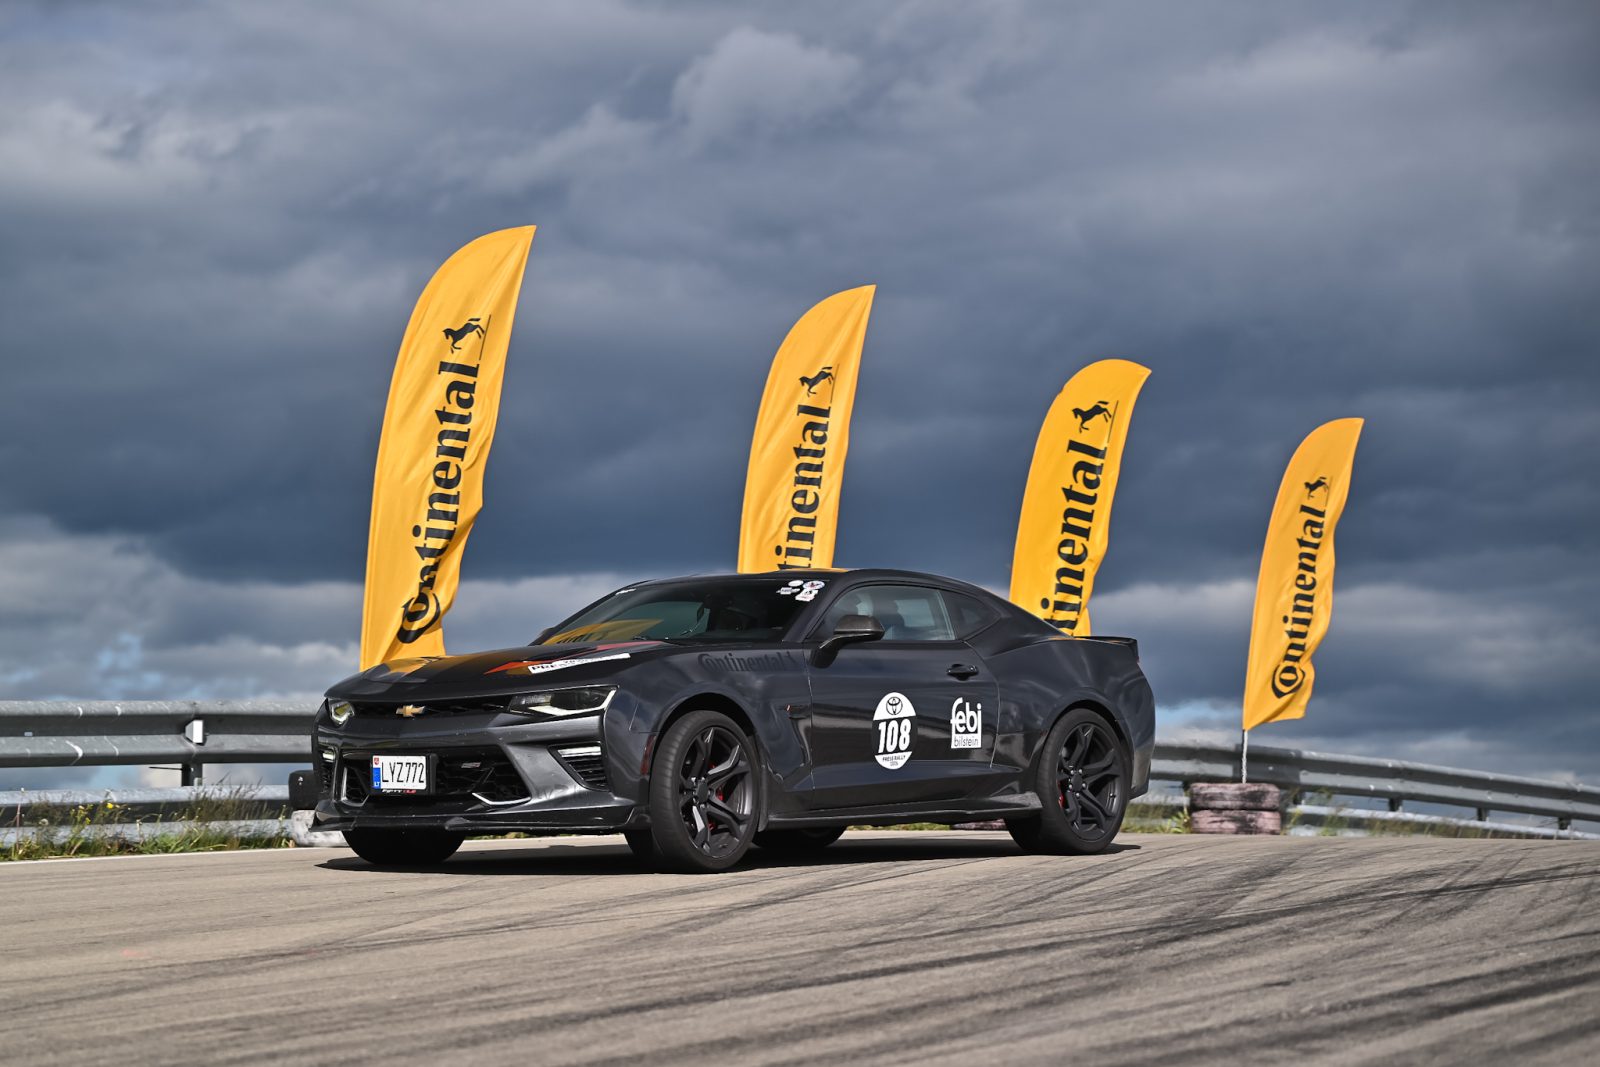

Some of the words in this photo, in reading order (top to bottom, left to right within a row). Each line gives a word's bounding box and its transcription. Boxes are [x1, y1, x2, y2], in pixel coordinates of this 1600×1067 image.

[396, 360, 480, 644] Continental
[1041, 439, 1107, 636] tinental
[1271, 504, 1326, 699] Continental
[698, 651, 785, 673] Continental
[950, 697, 982, 734] febi
[877, 718, 912, 753] 108
[953, 736, 979, 747] bilstein
[381, 762, 425, 783] LYZ772
